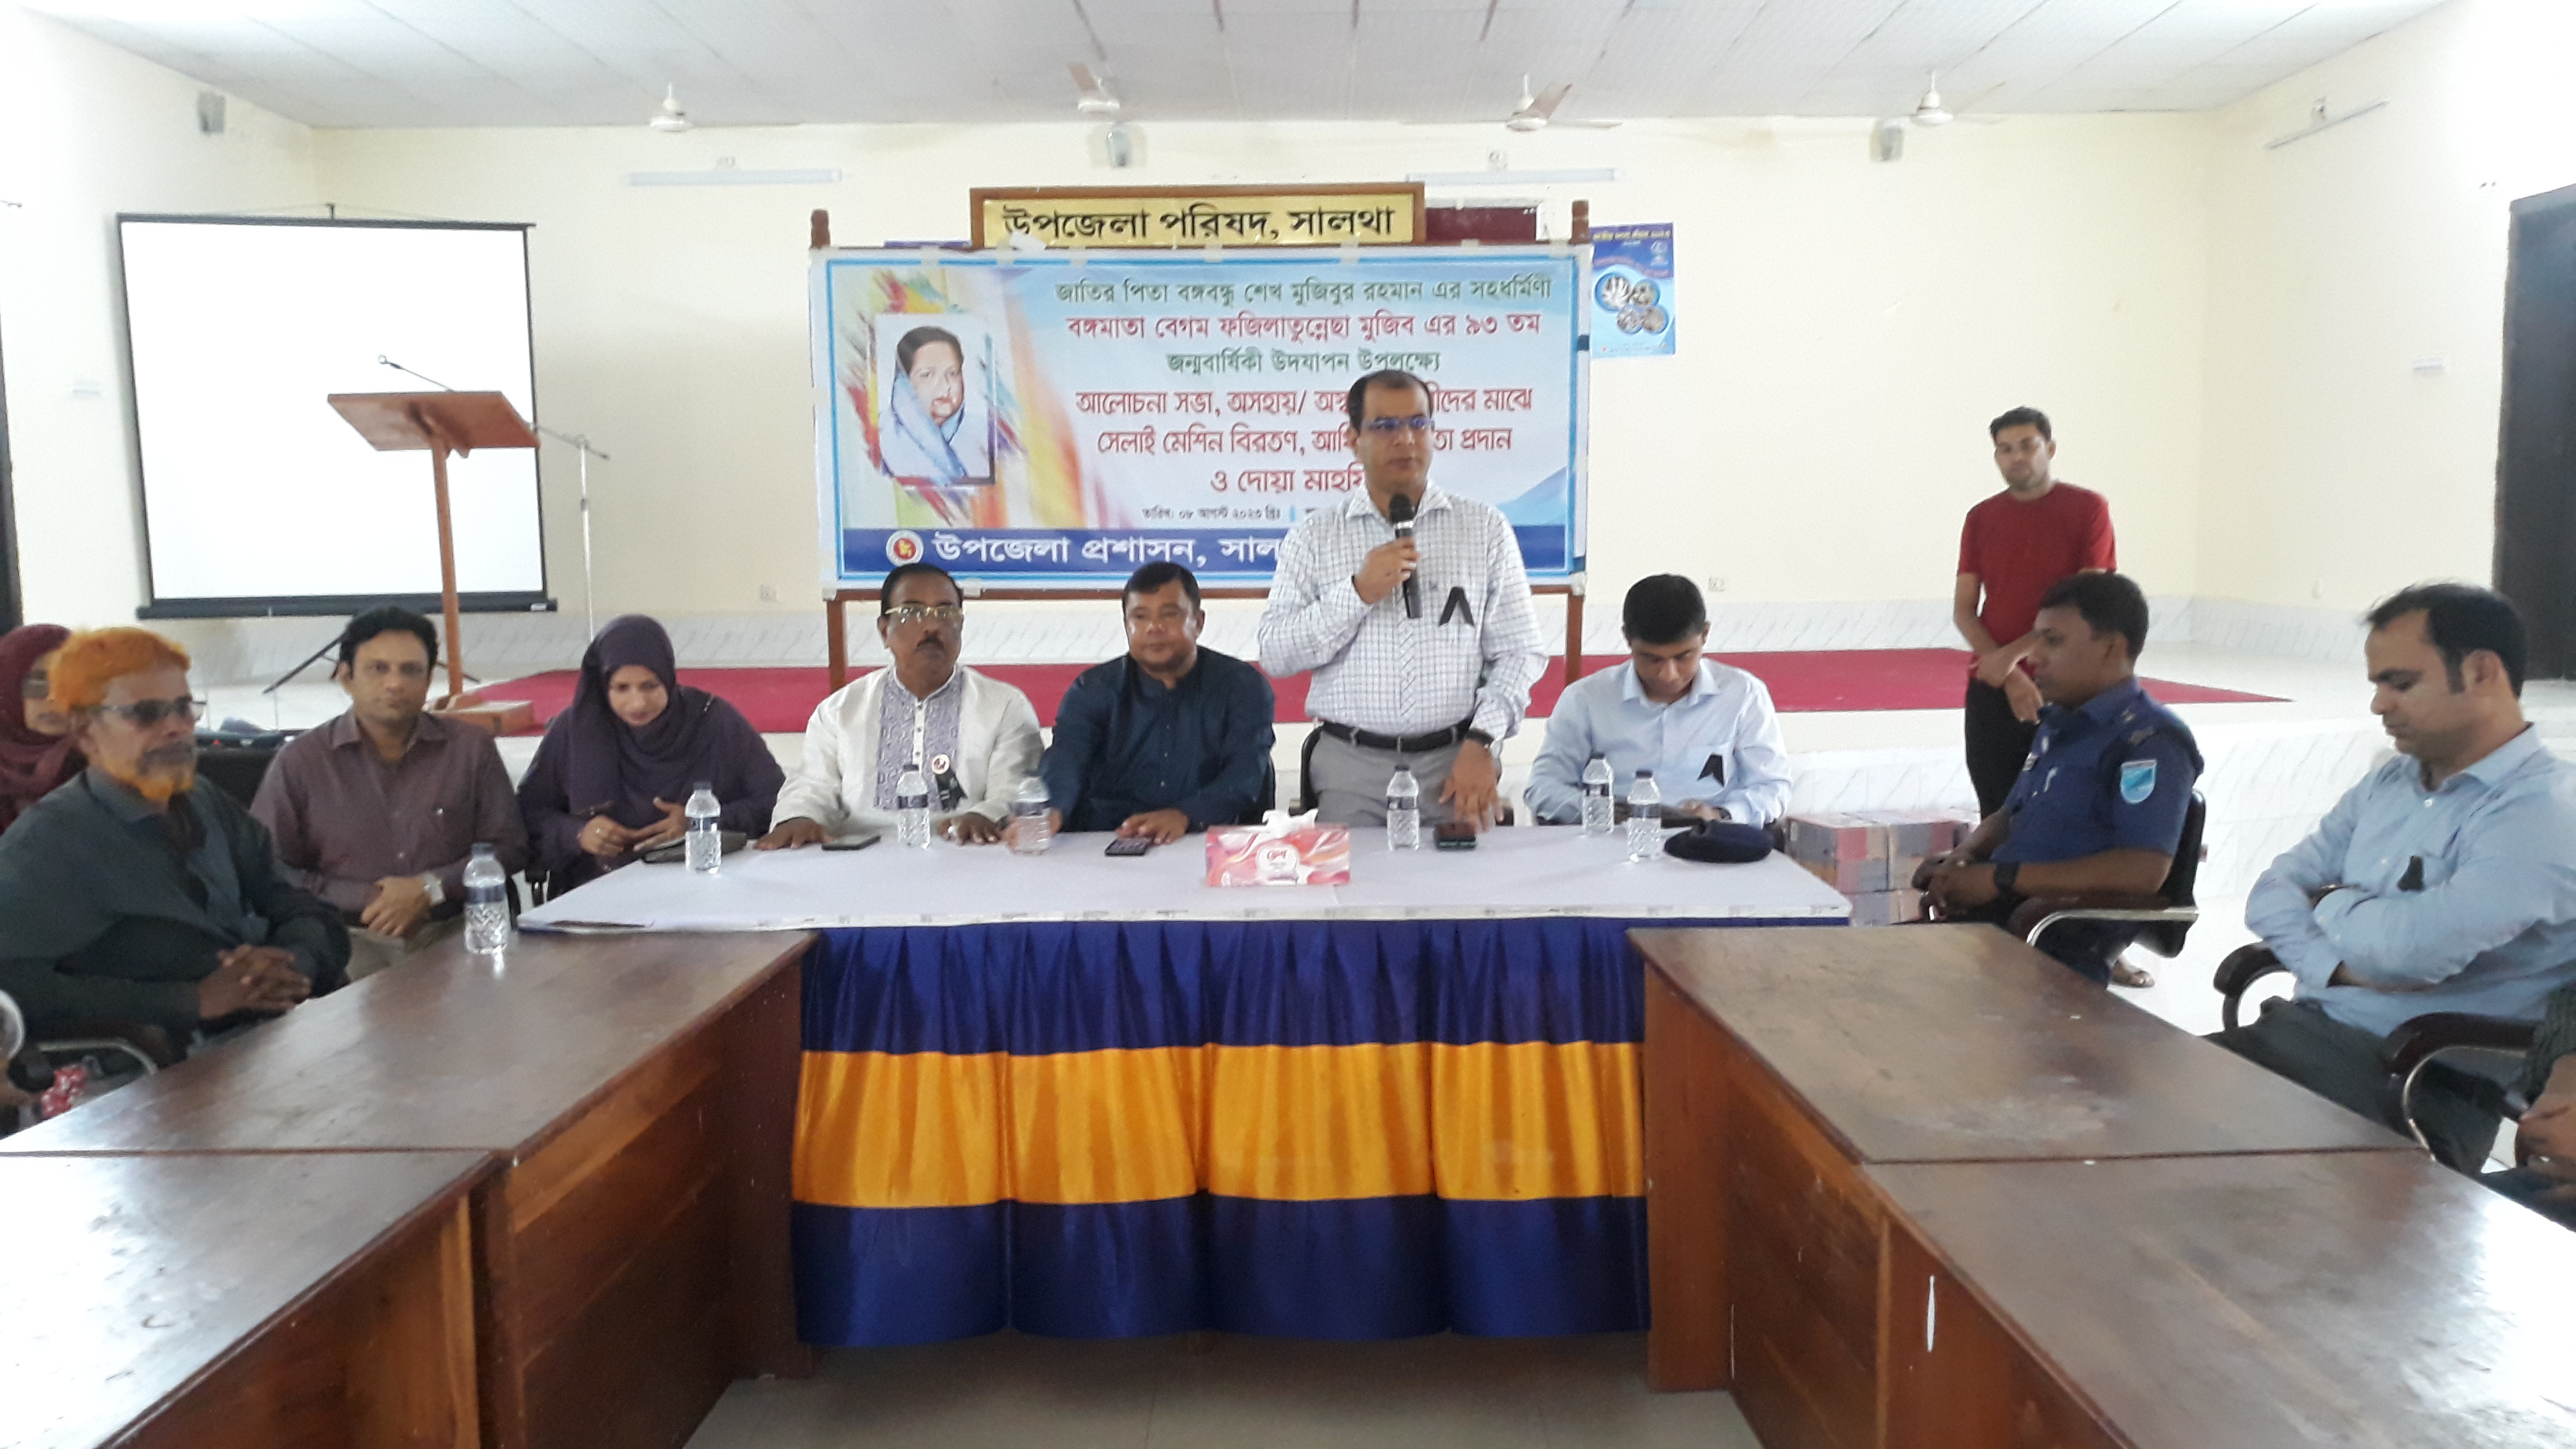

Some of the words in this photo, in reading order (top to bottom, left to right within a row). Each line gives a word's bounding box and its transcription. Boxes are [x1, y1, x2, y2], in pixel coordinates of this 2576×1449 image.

[1002, 204, 1150, 239] উপজেলা
[1159, 202, 1280, 240] পরিষদ,
[1287, 206, 1395, 236] সালথা
[1056, 278, 1115, 303] জাতির
[1123, 278, 1169, 303] পিতা
[1177, 283, 1235, 307] বঙ্গবন্ধু
[1245, 282, 1282, 303] শেখ
[1291, 276, 1355, 306] মুজিবুর
[1363, 281, 1423, 301] রহমান
[1432, 280, 1462, 299] এর
[1065, 316, 1146, 339] বঙ্গমাতা
[1155, 316, 1209, 339] বেগম
[1218, 310, 1351, 343] ফজিলাতুন্নেছা
[1358, 309, 1416, 342] মুজিব
[1424, 314, 1457, 335] এর
[1466, 314, 1498, 335] ৯৩
[1505, 313, 1541, 334] তম
[1166, 346, 1263, 375] জন্মবার্ষিকী
[1271, 347, 1350, 373] উদযাপন
[1076, 391, 1167, 414] আলোচনা
[1174, 391, 1221, 417] সভা,
[1484, 388, 1533, 411] মাঝে
[1098, 425, 1156, 455] সেলাই
[1163, 421, 1224, 454] মেশিন
[1461, 428, 1513, 451] প্রদান
[1211, 470, 1228, 492] ও
[1238, 470, 1297, 494] দোয়া
[1304, 460, 1365, 492] মাহফি
[932, 530, 1072, 563] উপজেলা
[1082, 536, 1208, 568] প্রশাসন,
